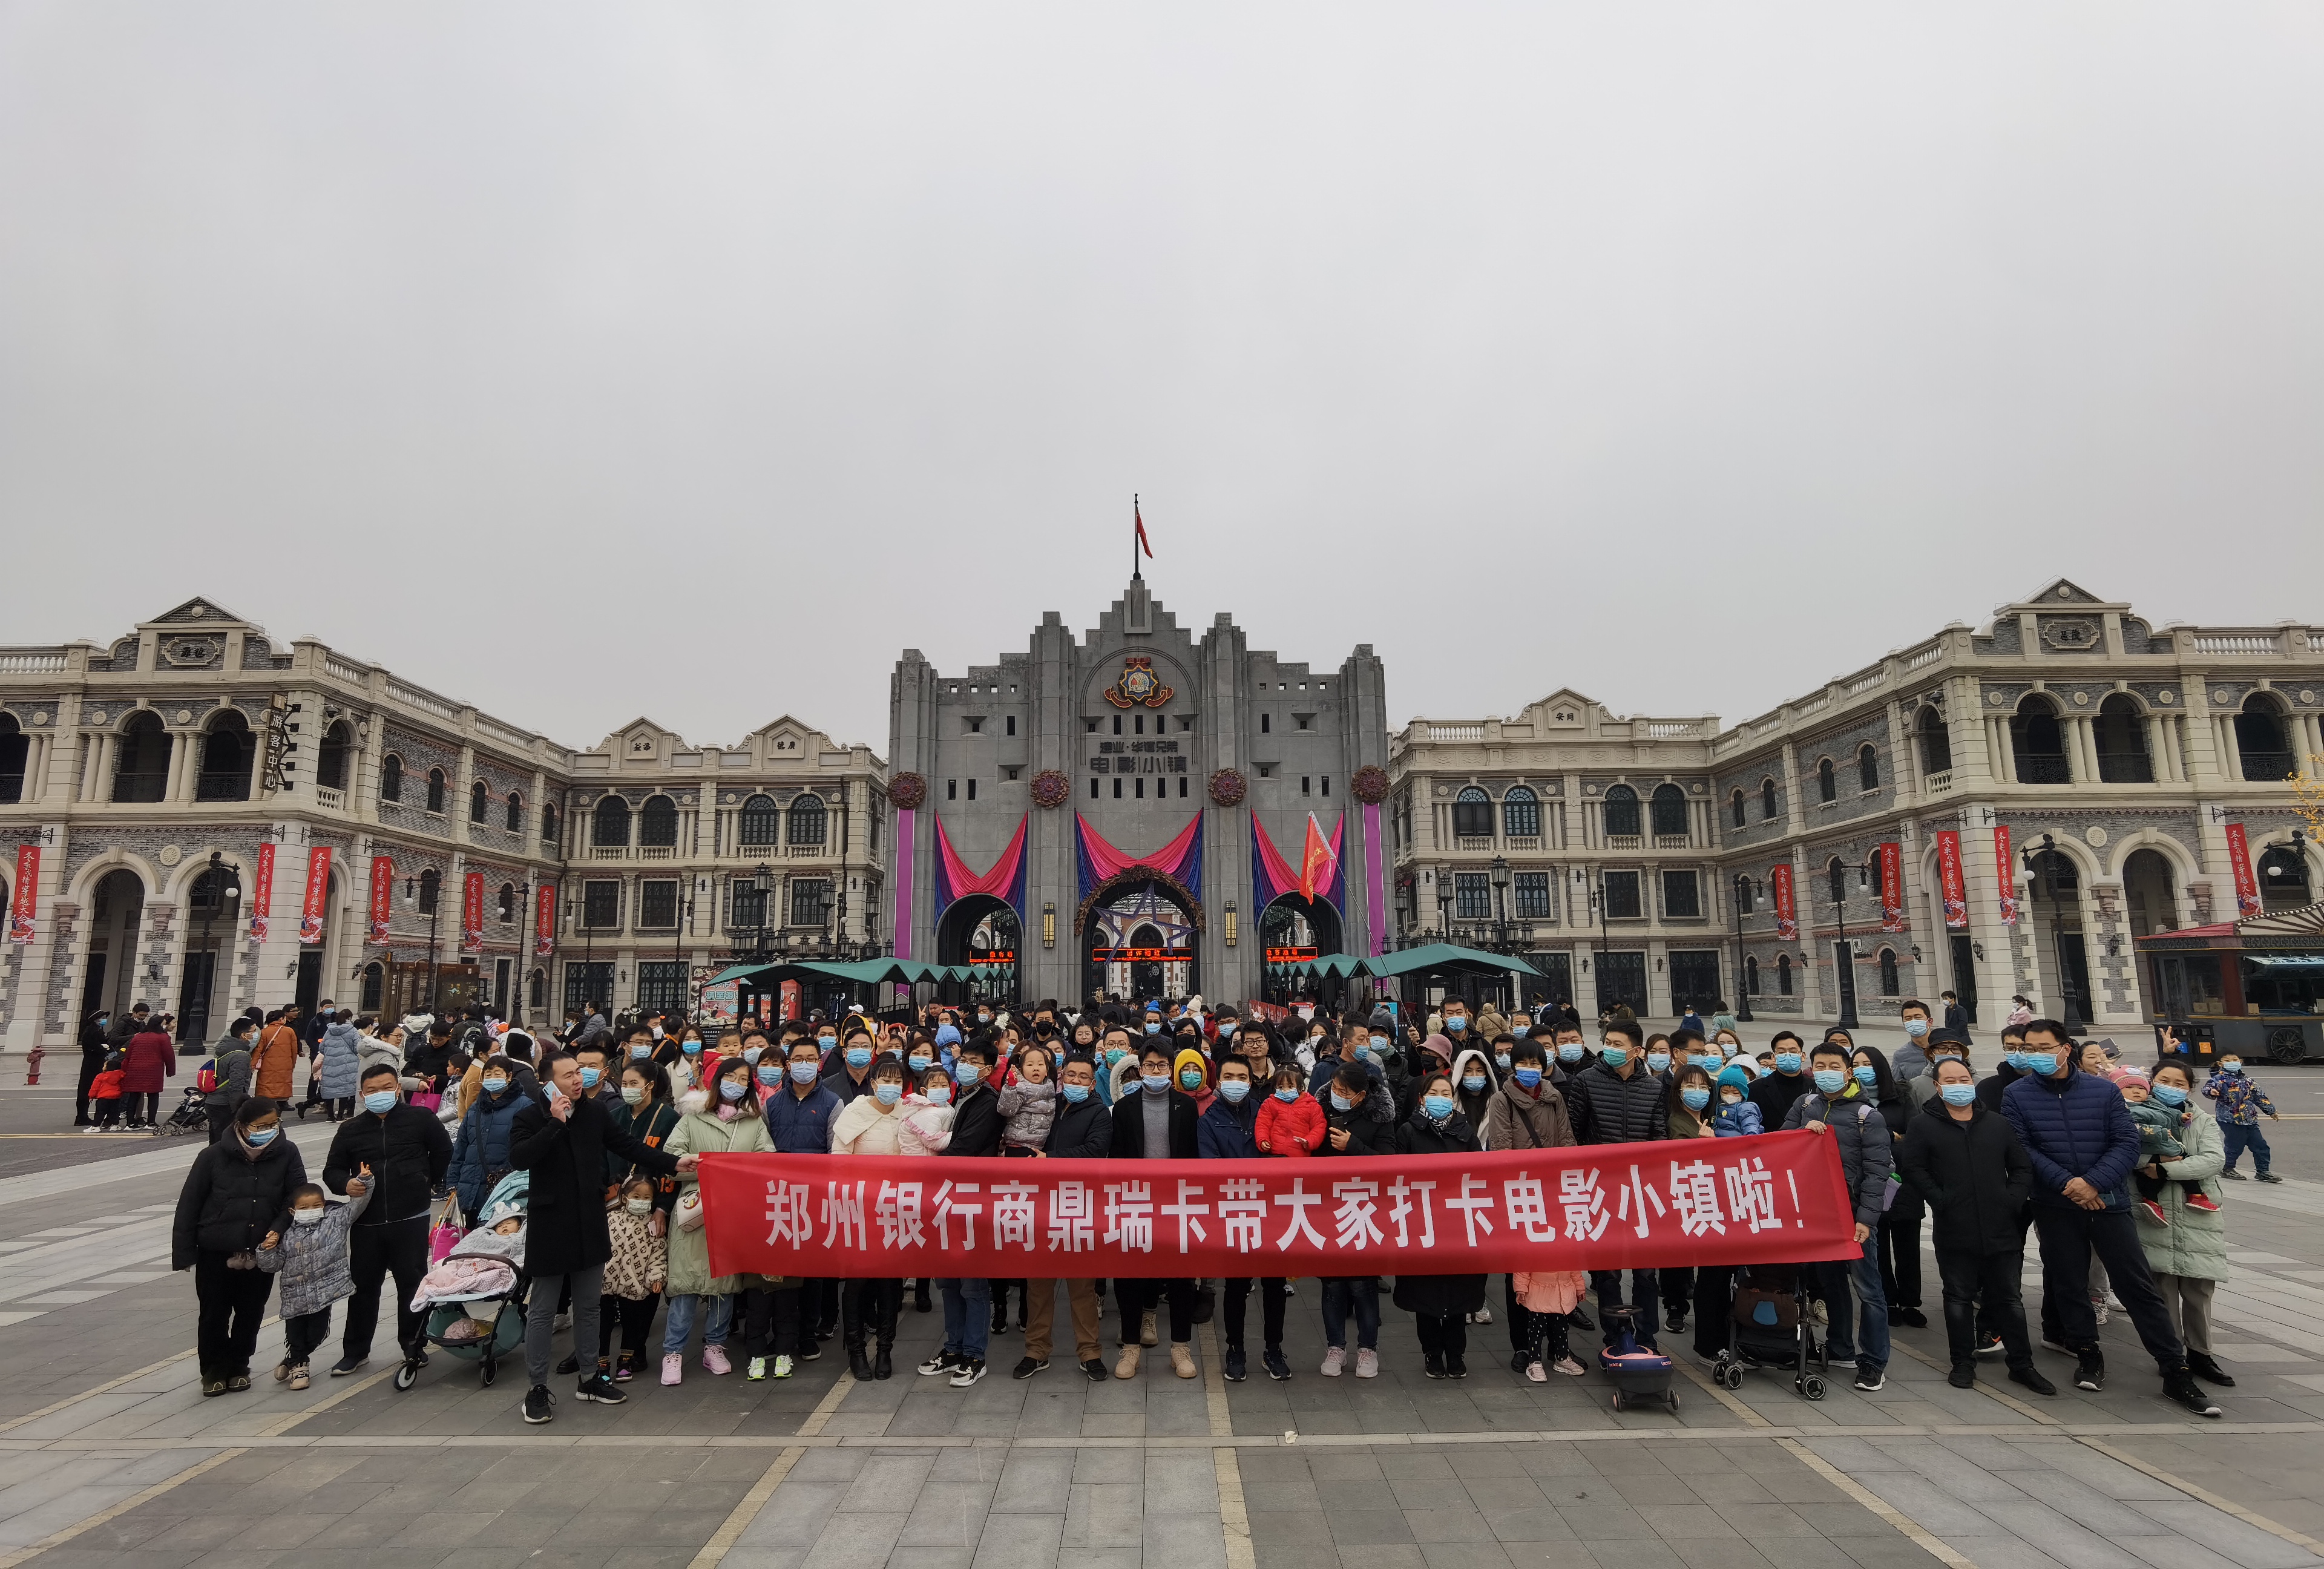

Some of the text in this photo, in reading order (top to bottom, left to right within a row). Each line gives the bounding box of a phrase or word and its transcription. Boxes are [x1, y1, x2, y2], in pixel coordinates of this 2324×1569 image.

[266, 715, 283, 788] 游客中心
[306, 852, 327, 923] 冬季戏精穿越大会
[1885, 848, 1897, 914] 冬季戏精穿越大会
[1942, 837, 1959, 907] 冬季戏精穿越大会
